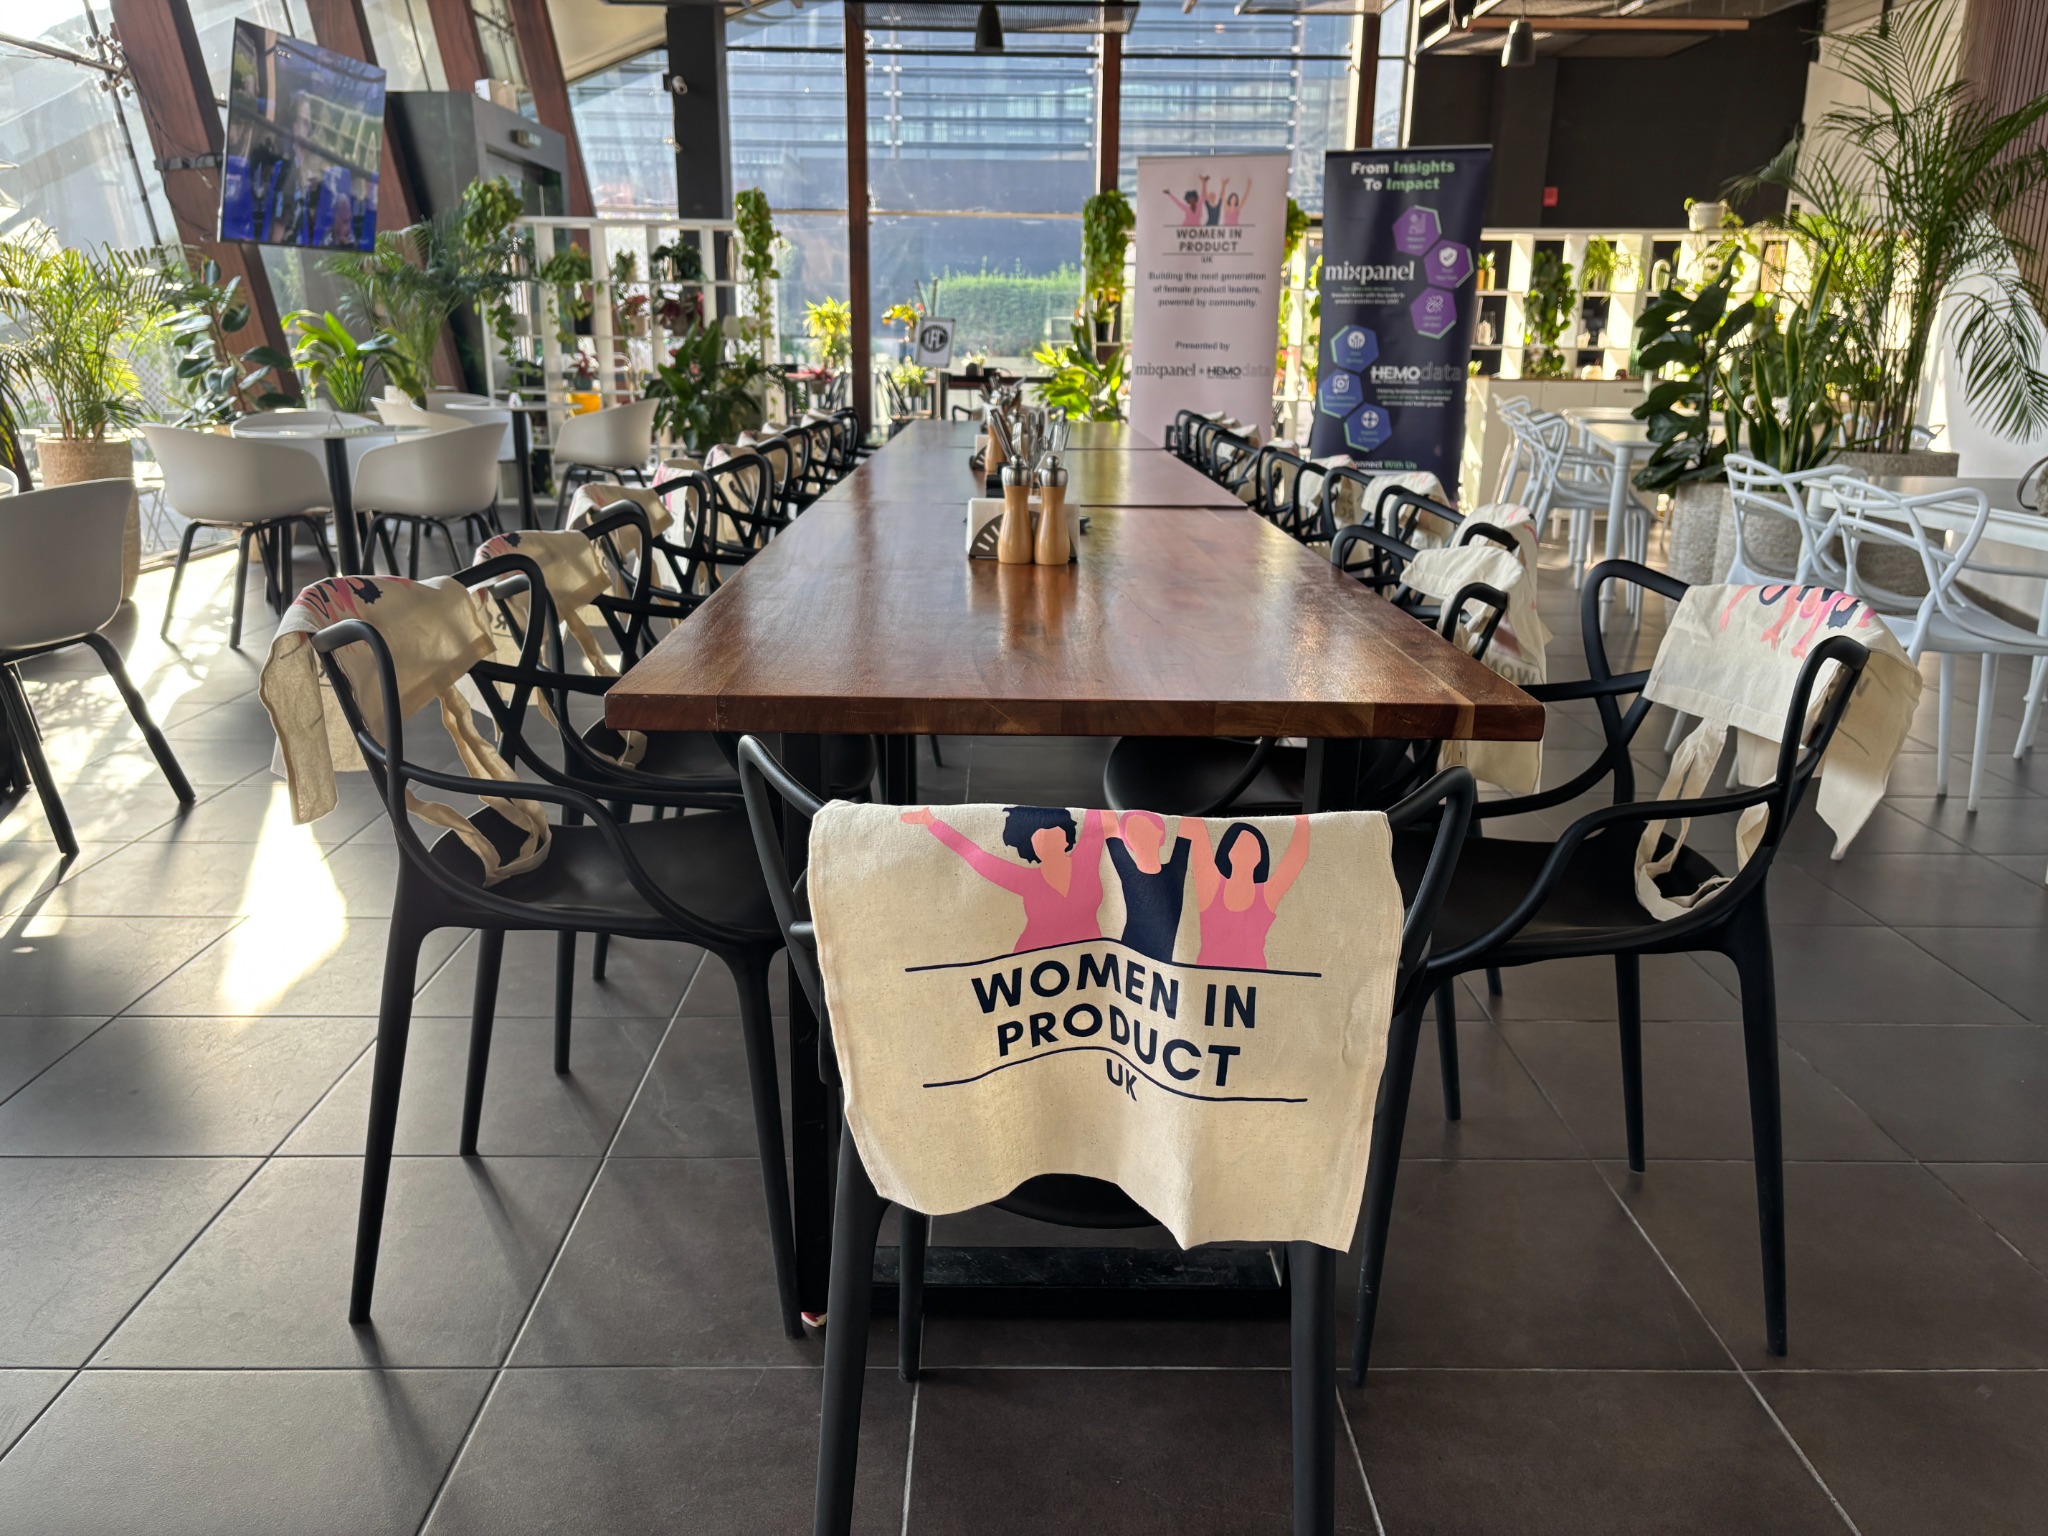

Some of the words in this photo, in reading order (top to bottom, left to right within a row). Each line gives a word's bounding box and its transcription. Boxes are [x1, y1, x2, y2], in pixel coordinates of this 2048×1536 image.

[1351, 162, 1389, 175] From
[1393, 161, 1455, 176] Insights
[1363, 178, 1382, 191] To
[1386, 177, 1440, 193] Impact
[1176, 229, 1225, 239] WOMEN
[1229, 229, 1242, 239] IN
[1179, 241, 1238, 252] PRODUCT
[1148, 272, 1183, 281] Building
[1185, 272, 1198, 280] the
[1201, 272, 1219, 280] next
[1221, 272, 1266, 281] generation
[1325, 261, 1415, 285] mixpanel
[1153, 285, 1161, 293] of
[1163, 285, 1191, 293] female
[1193, 285, 1226, 295] product
[1158, 299, 1195, 308] powered
[1197, 299, 1206, 308] by
[1175, 341, 1218, 350] Presented
[1220, 341, 1230, 351] by
[1135, 362, 1196, 379] mixpanel
[1355, 461, 1383, 470] onnect
[1384, 461, 1404, 469] With
[1405, 461, 1417, 470] Us
[971, 953, 1179, 1020] WOMEN
[1204, 983, 1257, 1029] IN
[997, 1003, 1241, 1087] PRODUCT
[1106, 1058, 1137, 1102] UK
